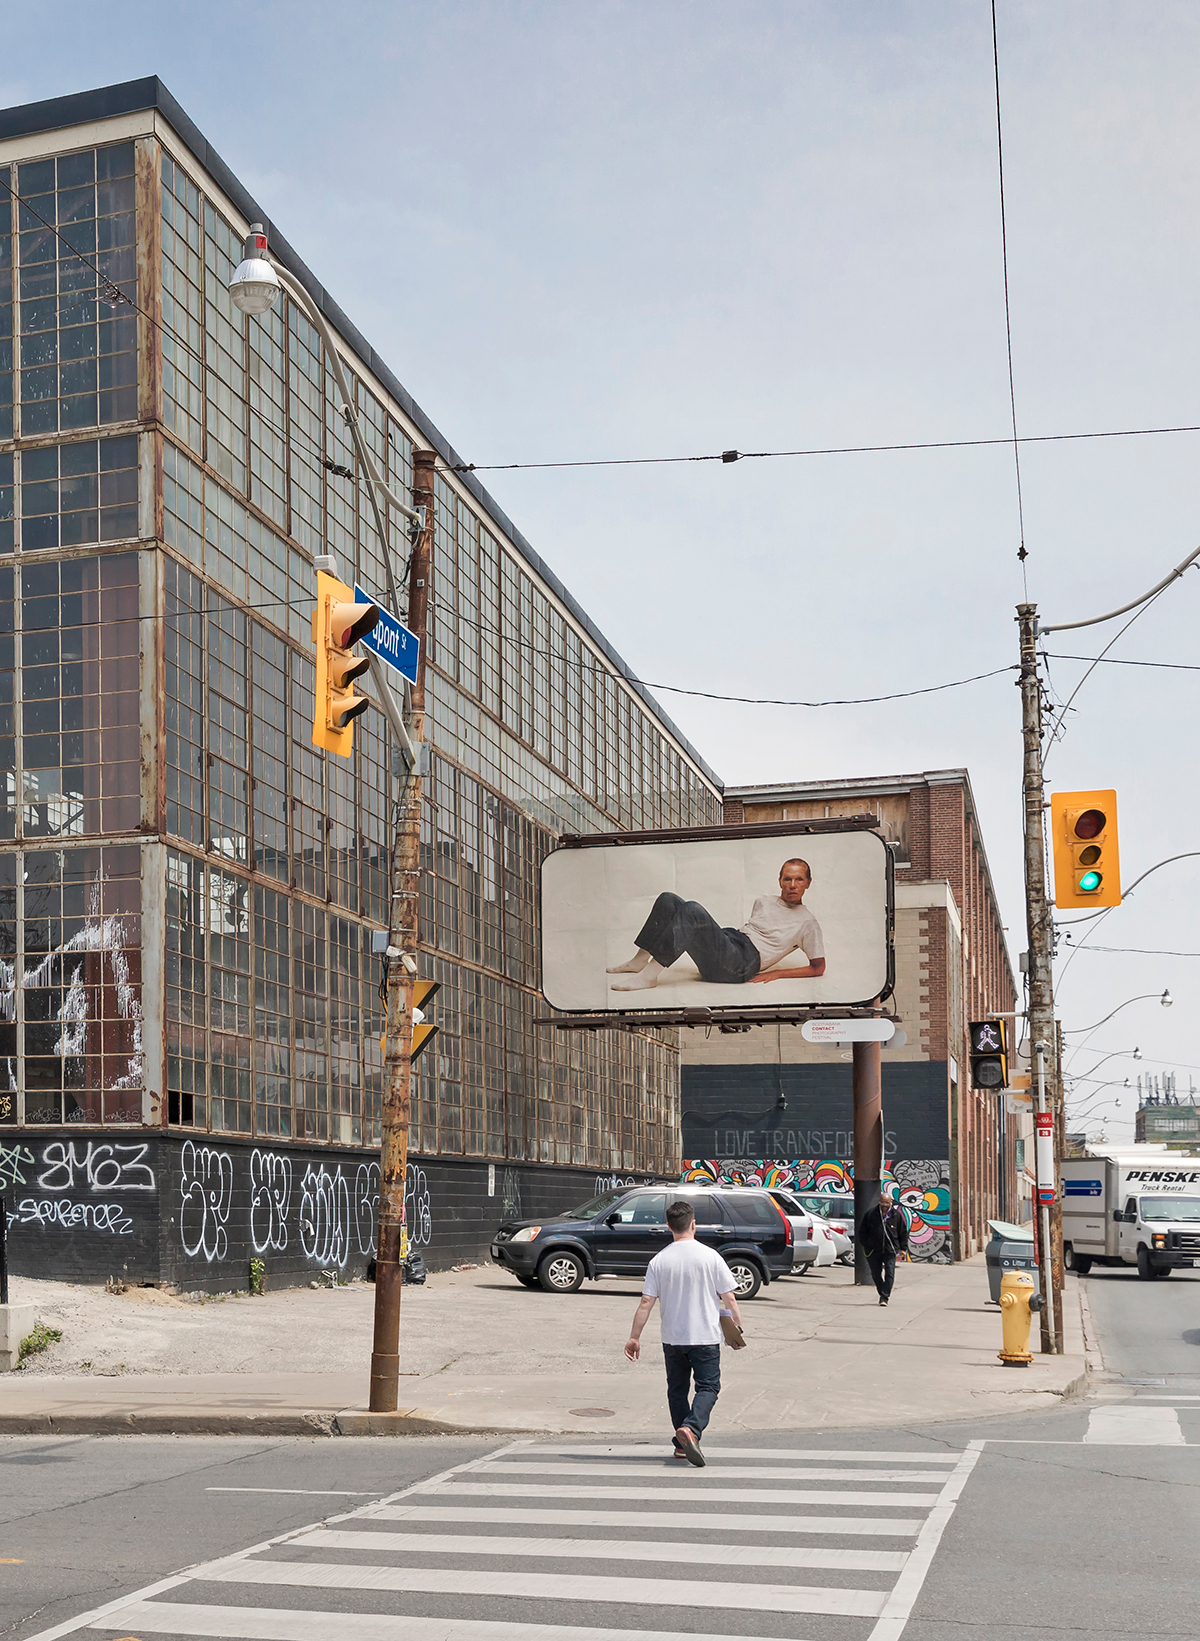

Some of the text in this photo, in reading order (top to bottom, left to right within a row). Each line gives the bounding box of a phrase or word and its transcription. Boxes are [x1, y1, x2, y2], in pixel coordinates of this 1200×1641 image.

[372, 620, 407, 657] upont St
[715, 1129, 898, 1156] LOVE TRANSFOS
[1125, 1171, 1200, 1183] PENSKE
